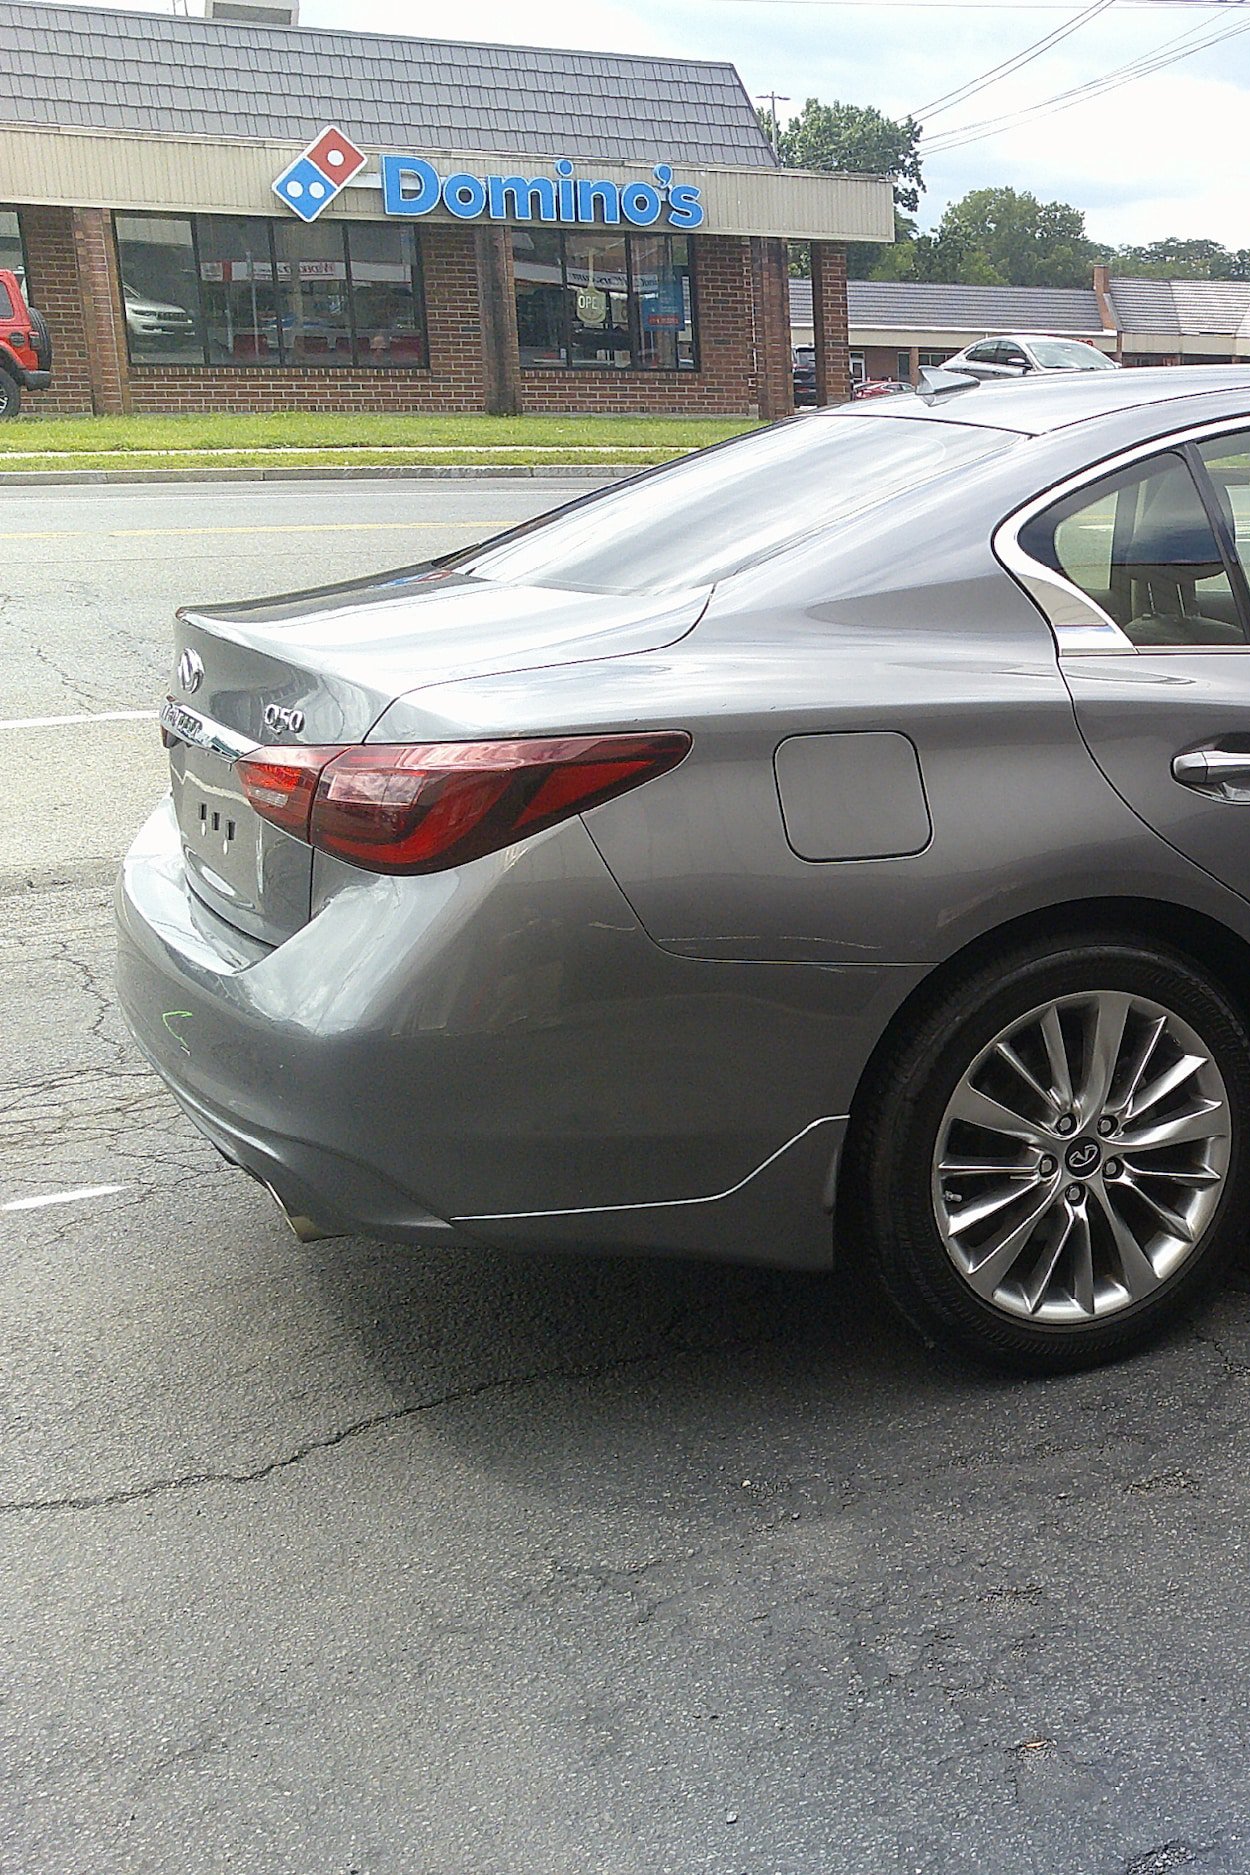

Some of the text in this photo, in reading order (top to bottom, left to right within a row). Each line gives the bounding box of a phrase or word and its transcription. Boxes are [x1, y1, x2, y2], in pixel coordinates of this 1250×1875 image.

[381, 154, 705, 229] Domino's
[577, 295, 600, 310] OPE
[265, 704, 304, 734] Q50
